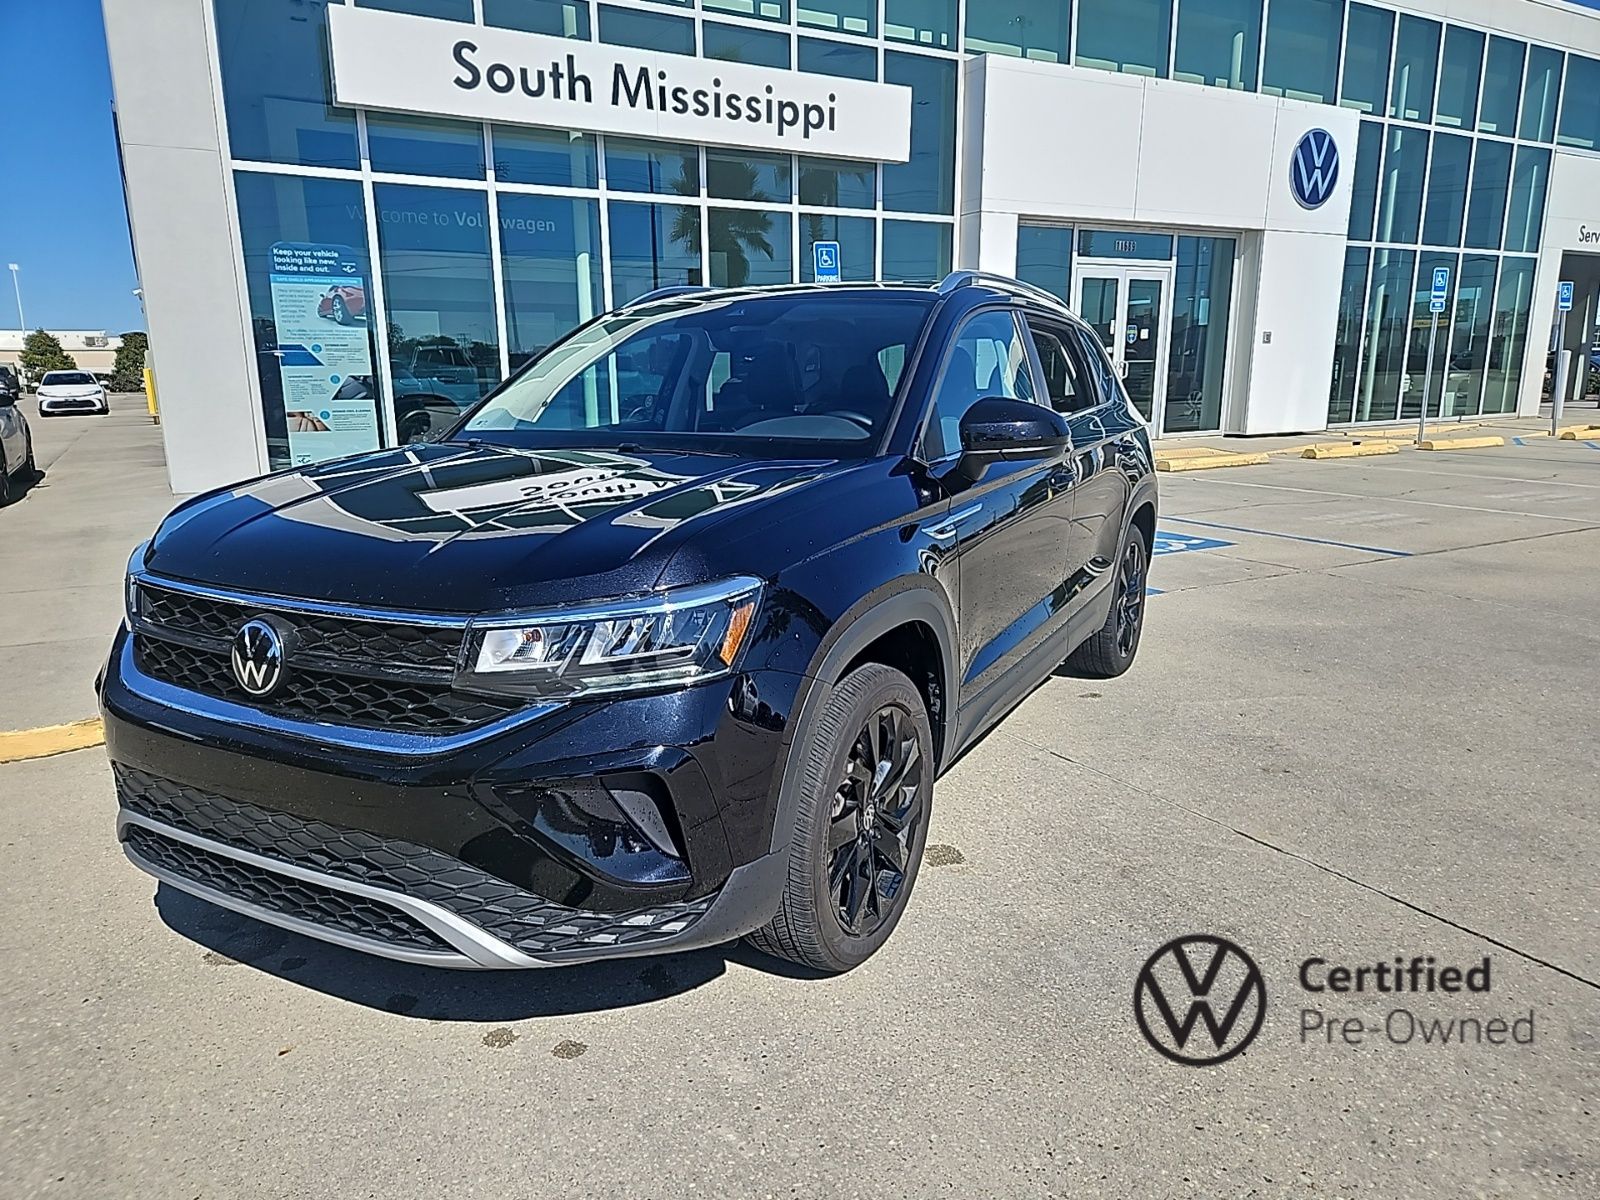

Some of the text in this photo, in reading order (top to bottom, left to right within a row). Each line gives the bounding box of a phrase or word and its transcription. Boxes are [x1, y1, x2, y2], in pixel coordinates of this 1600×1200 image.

[452, 40, 837, 139] South Mississippi
[1292, 130, 1338, 202] VW
[345, 204, 556, 234] Wcome to Volwagen
[272, 247, 339, 258] Keep your vehicle
[273, 256, 302, 265] looking
